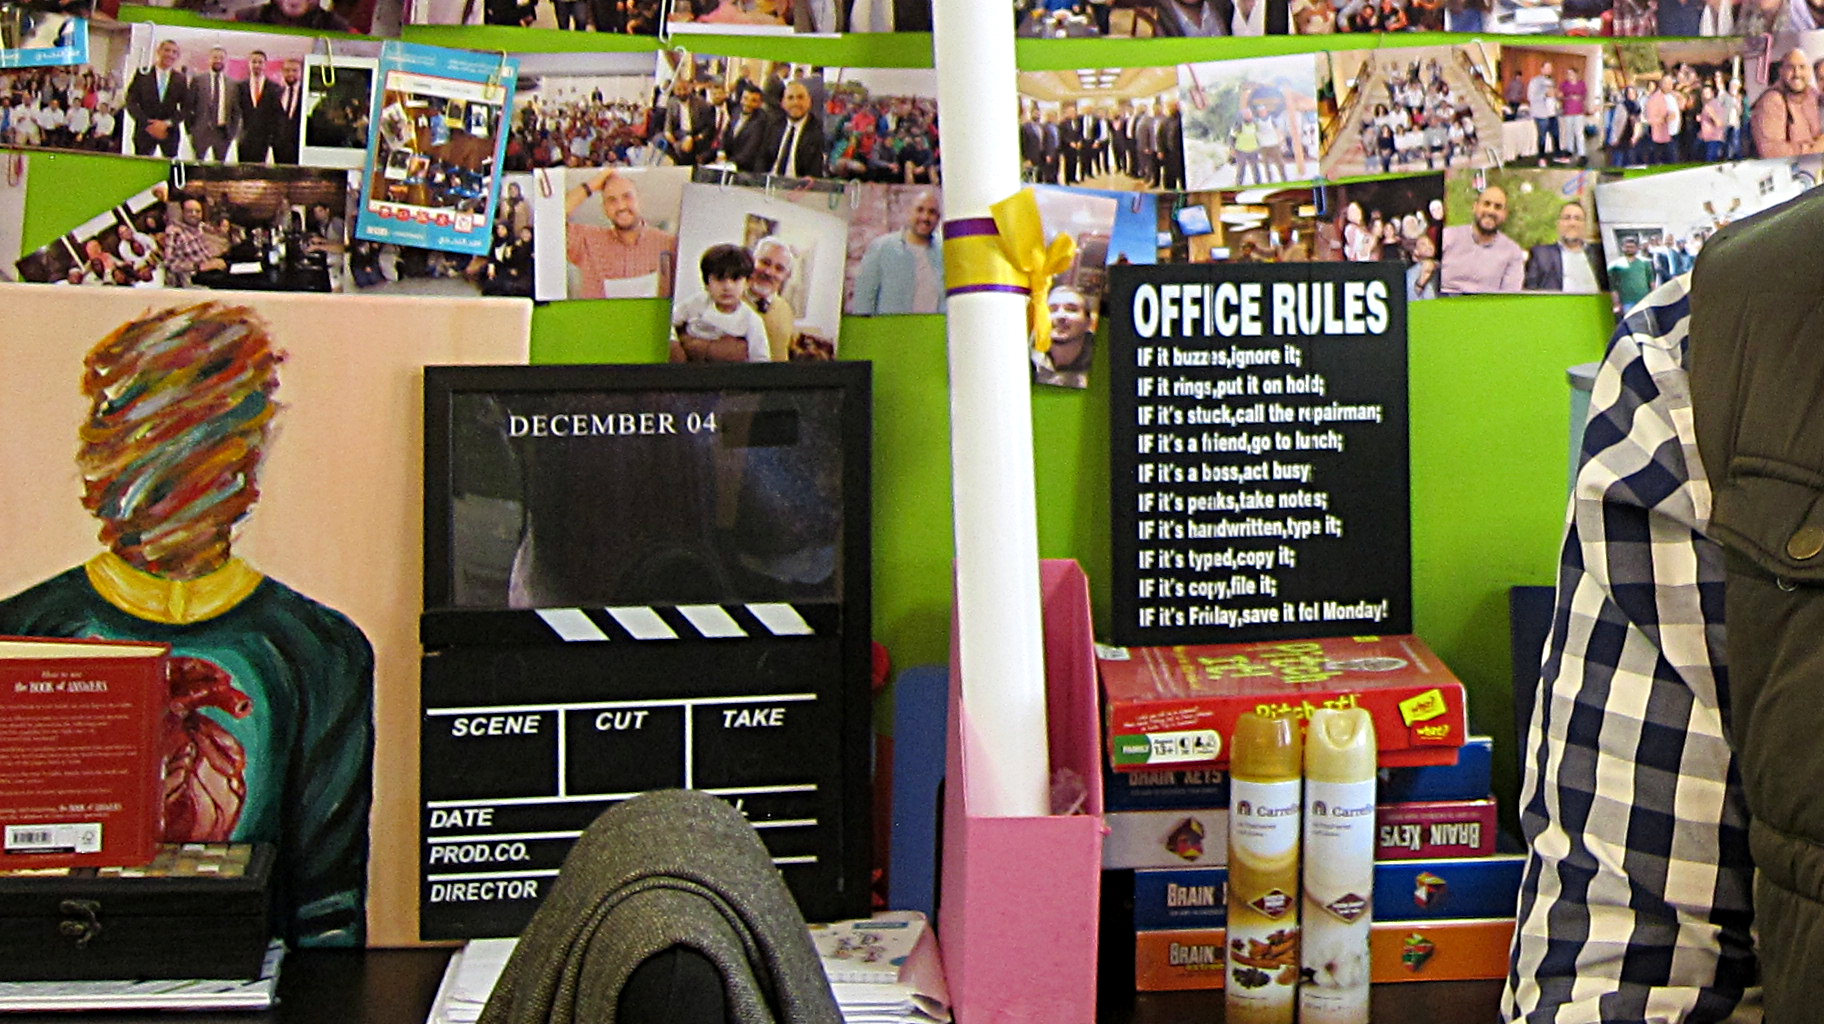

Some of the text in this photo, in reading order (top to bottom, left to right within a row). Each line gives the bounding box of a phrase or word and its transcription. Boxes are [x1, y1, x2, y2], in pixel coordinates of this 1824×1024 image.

[1133, 280, 1389, 338] OFFICE RULES
[1137, 347, 1154, 367] IF
[1157, 346, 1169, 367] it
[1284, 344, 1303, 367] it;
[1137, 374, 1326, 399] IF it rings,put it on hold;
[508, 411, 717, 437] DECEMBER 04
[1137, 401, 1383, 427] IF it's stuck,call the repairman;
[1138, 435, 1154, 454] IF
[1157, 433, 1184, 454] it's
[1187, 439, 1199, 453] a
[1275, 431, 1293, 451] to
[1295, 430, 1343, 453] lunch;
[1138, 464, 1154, 483] IF
[1157, 463, 1184, 483] it's
[1187, 468, 1199, 483] a
[1201, 462, 1270, 485] boss,act
[1138, 493, 1154, 513] IF
[1157, 492, 1184, 512] it's
[1278, 490, 1329, 511] notes;
[1138, 514, 1343, 540] IF it's handwritten,type it;
[1138, 545, 1296, 572] IF it's typed,copy it;
[1138, 574, 1278, 600] IF it's copy,file it;
[1139, 608, 1155, 627] IF
[1158, 607, 1185, 626] it's
[1283, 603, 1295, 622] it
[1323, 599, 1388, 623] Monday!
[451, 715, 541, 737] SCENE
[594, 711, 649, 730] CUT
[722, 708, 786, 728] TAKE
[430, 808, 494, 828] DATE
[1380, 824, 1421, 851] KEYS
[1430, 823, 1480, 849] BRAIN
[429, 843, 530, 865] PROD.CO.
[430, 880, 538, 902] DIRECTOR
[1167, 883, 1216, 907] BRAIN
[1170, 942, 1216, 965] BRAIN
